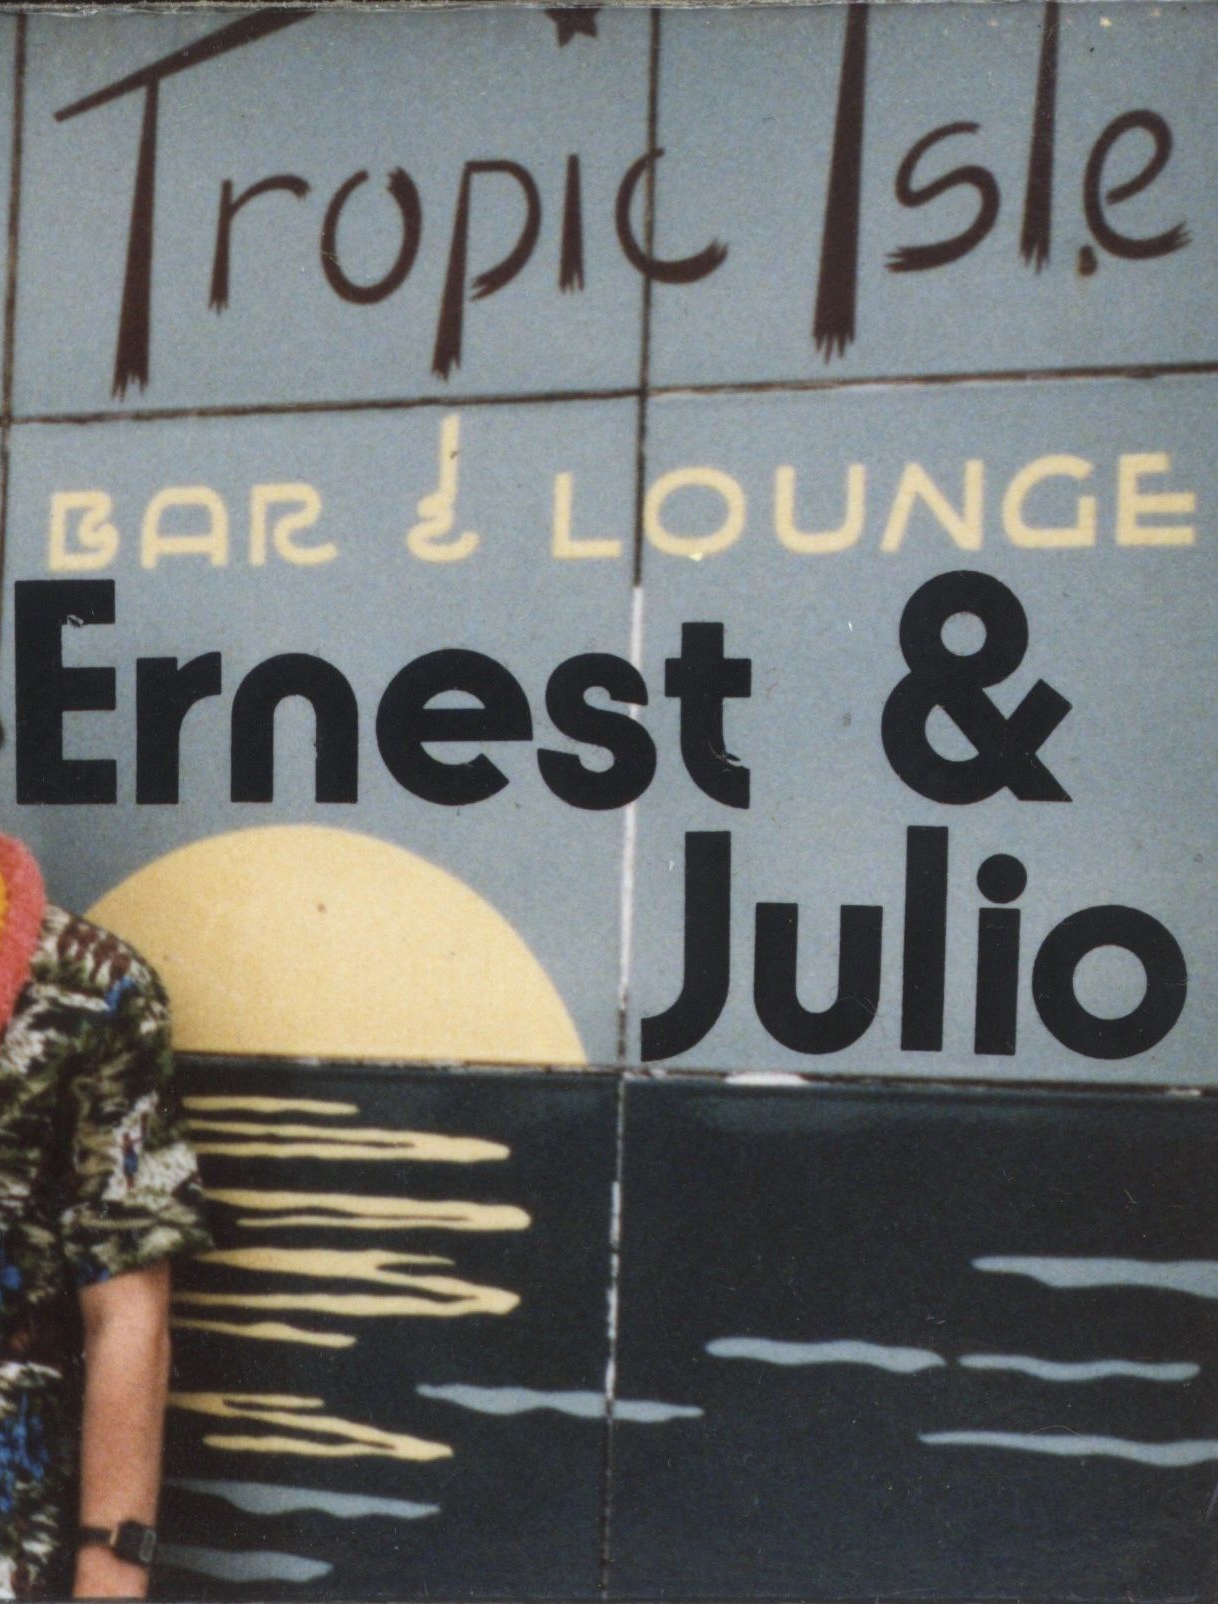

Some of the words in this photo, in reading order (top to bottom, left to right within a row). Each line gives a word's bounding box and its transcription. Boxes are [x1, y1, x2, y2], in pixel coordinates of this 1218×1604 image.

[54, 10, 729, 398] Tropic
[813, 5, 1192, 364] Isle
[47, 483, 337, 572] BAR
[552, 452, 1197, 561] LOUNGE
